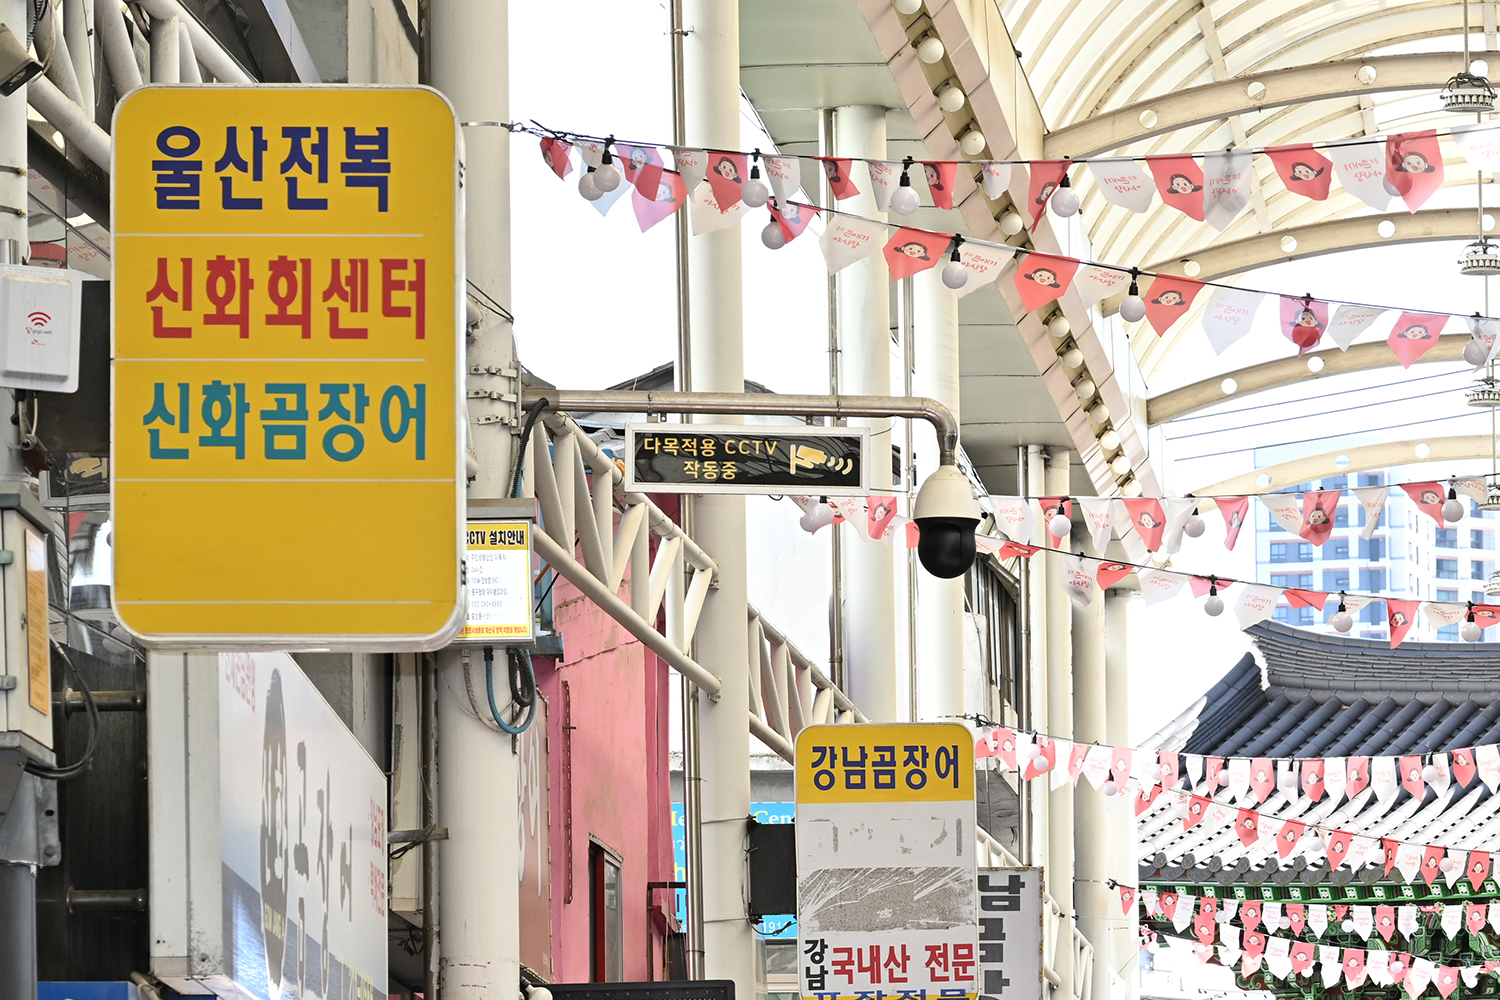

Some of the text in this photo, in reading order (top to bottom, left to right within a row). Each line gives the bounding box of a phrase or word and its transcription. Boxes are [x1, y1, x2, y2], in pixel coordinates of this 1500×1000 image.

[151, 125, 391, 212] 울산전복
[145, 255, 426, 340] 신화회센터
[142, 380, 427, 462] 신화곰장어
[643, 437, 778, 458] 다목적용 CCTV
[683, 459, 738, 480] 작동중
[489, 530, 525, 545] 설치안내
[811, 744, 960, 791] 강남곰장어
[831, 943, 976, 985] 국내산 전문
